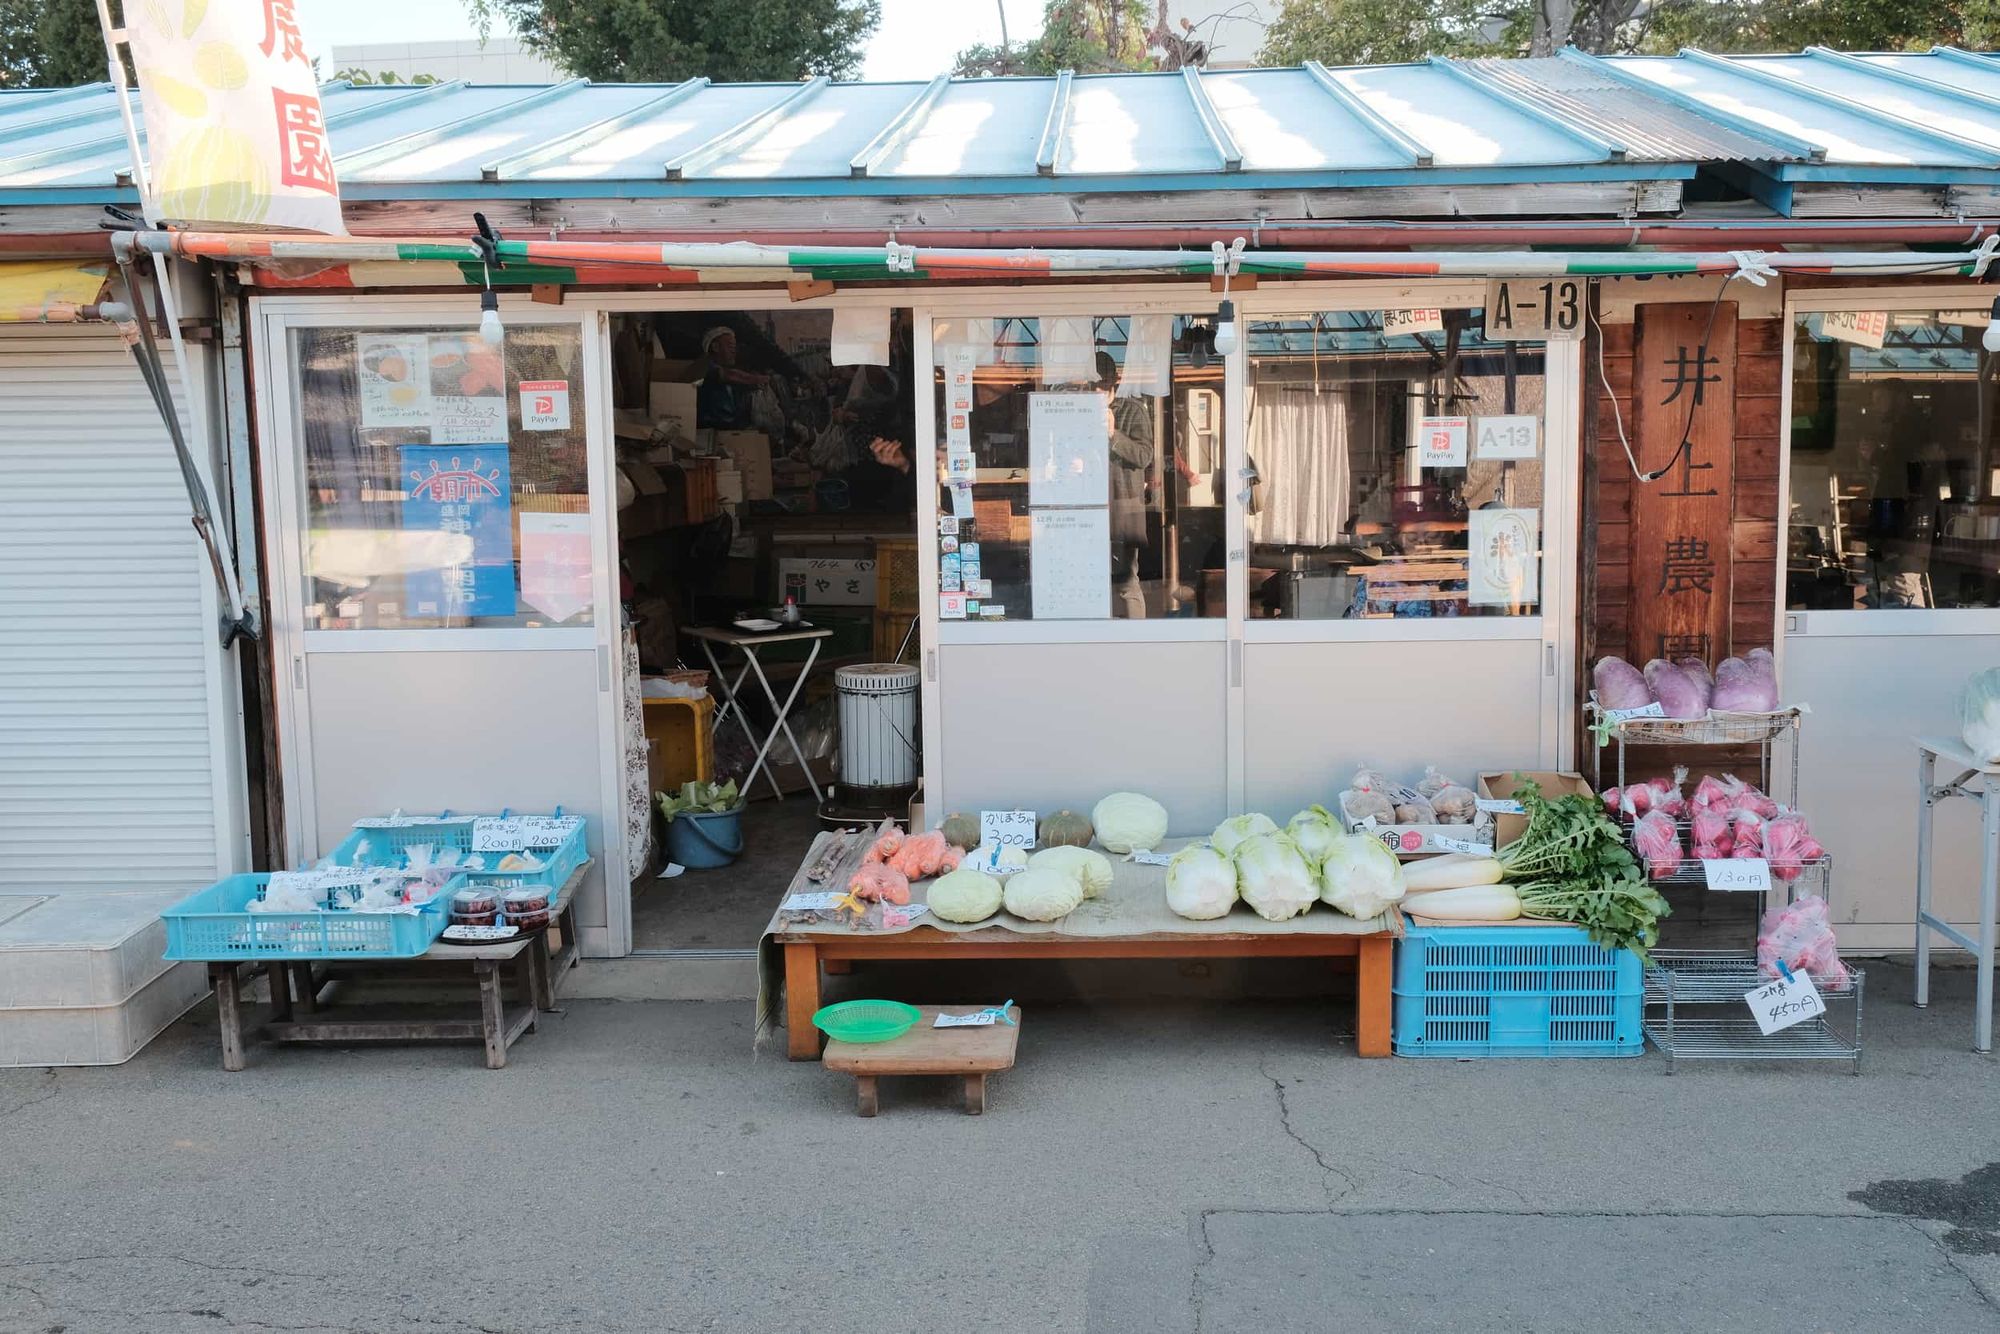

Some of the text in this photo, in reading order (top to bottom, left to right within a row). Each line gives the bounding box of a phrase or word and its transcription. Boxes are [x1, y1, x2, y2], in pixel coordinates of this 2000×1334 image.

[1493, 282, 1579, 330] A-13
[531, 415, 559, 424] PayPay
[1480, 426, 1531, 447] A-13
[1426, 451, 1455, 460] PayPay
[430, 473, 482, 502] 朝市
[985, 812, 1035, 826] かぼちゃ
[480, 834, 521, 849] 200円
[988, 829, 1034, 847] 300円
[1714, 870, 1762, 885] 130円
[1769, 995, 1818, 1023] 450円
